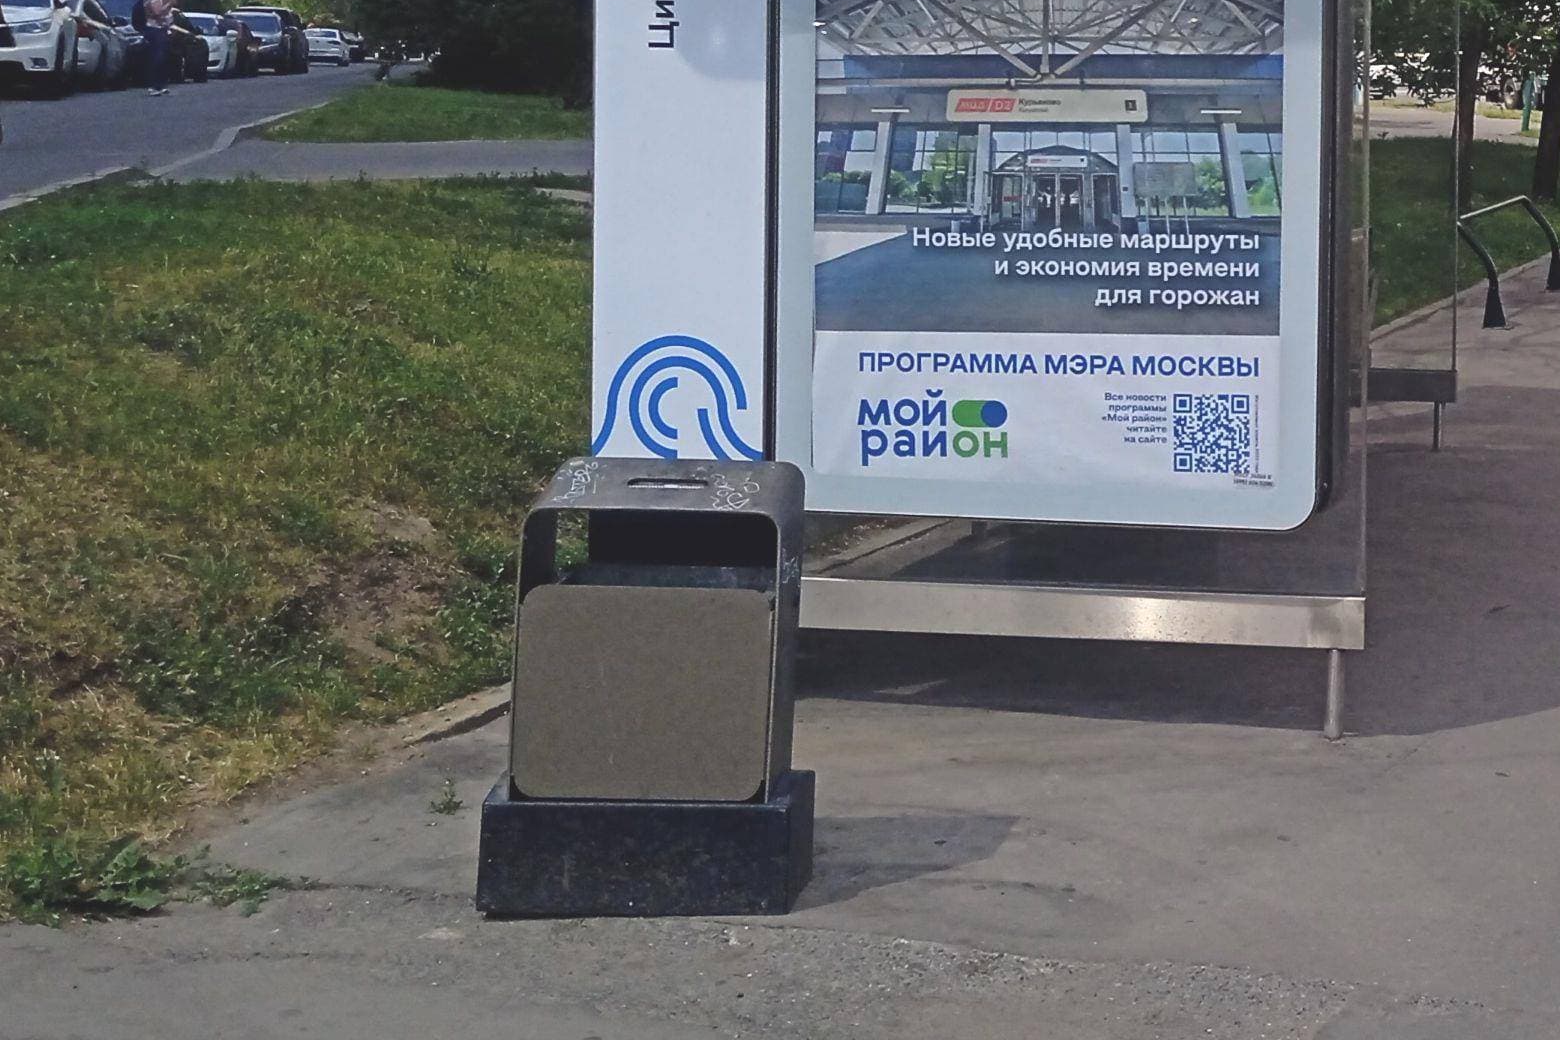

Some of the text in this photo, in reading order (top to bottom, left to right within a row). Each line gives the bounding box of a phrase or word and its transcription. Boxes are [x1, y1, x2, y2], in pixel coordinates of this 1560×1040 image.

[912, 228, 1261, 253] Новые удобные маршруты
[994, 260, 1260, 281] и экономия времени
[1094, 288, 1260, 309] для горожан
[858, 351, 1260, 378] ПРОГРАММА МЭРА МОСКВЫ
[1104, 392, 1167, 402] Все новости
[857, 389, 947, 427] мой
[1108, 405, 1167, 413] программы
[1102, 413, 1167, 424] «Мой район»
[1126, 425, 1168, 434] читайте
[1123, 435, 1168, 444] на сайте
